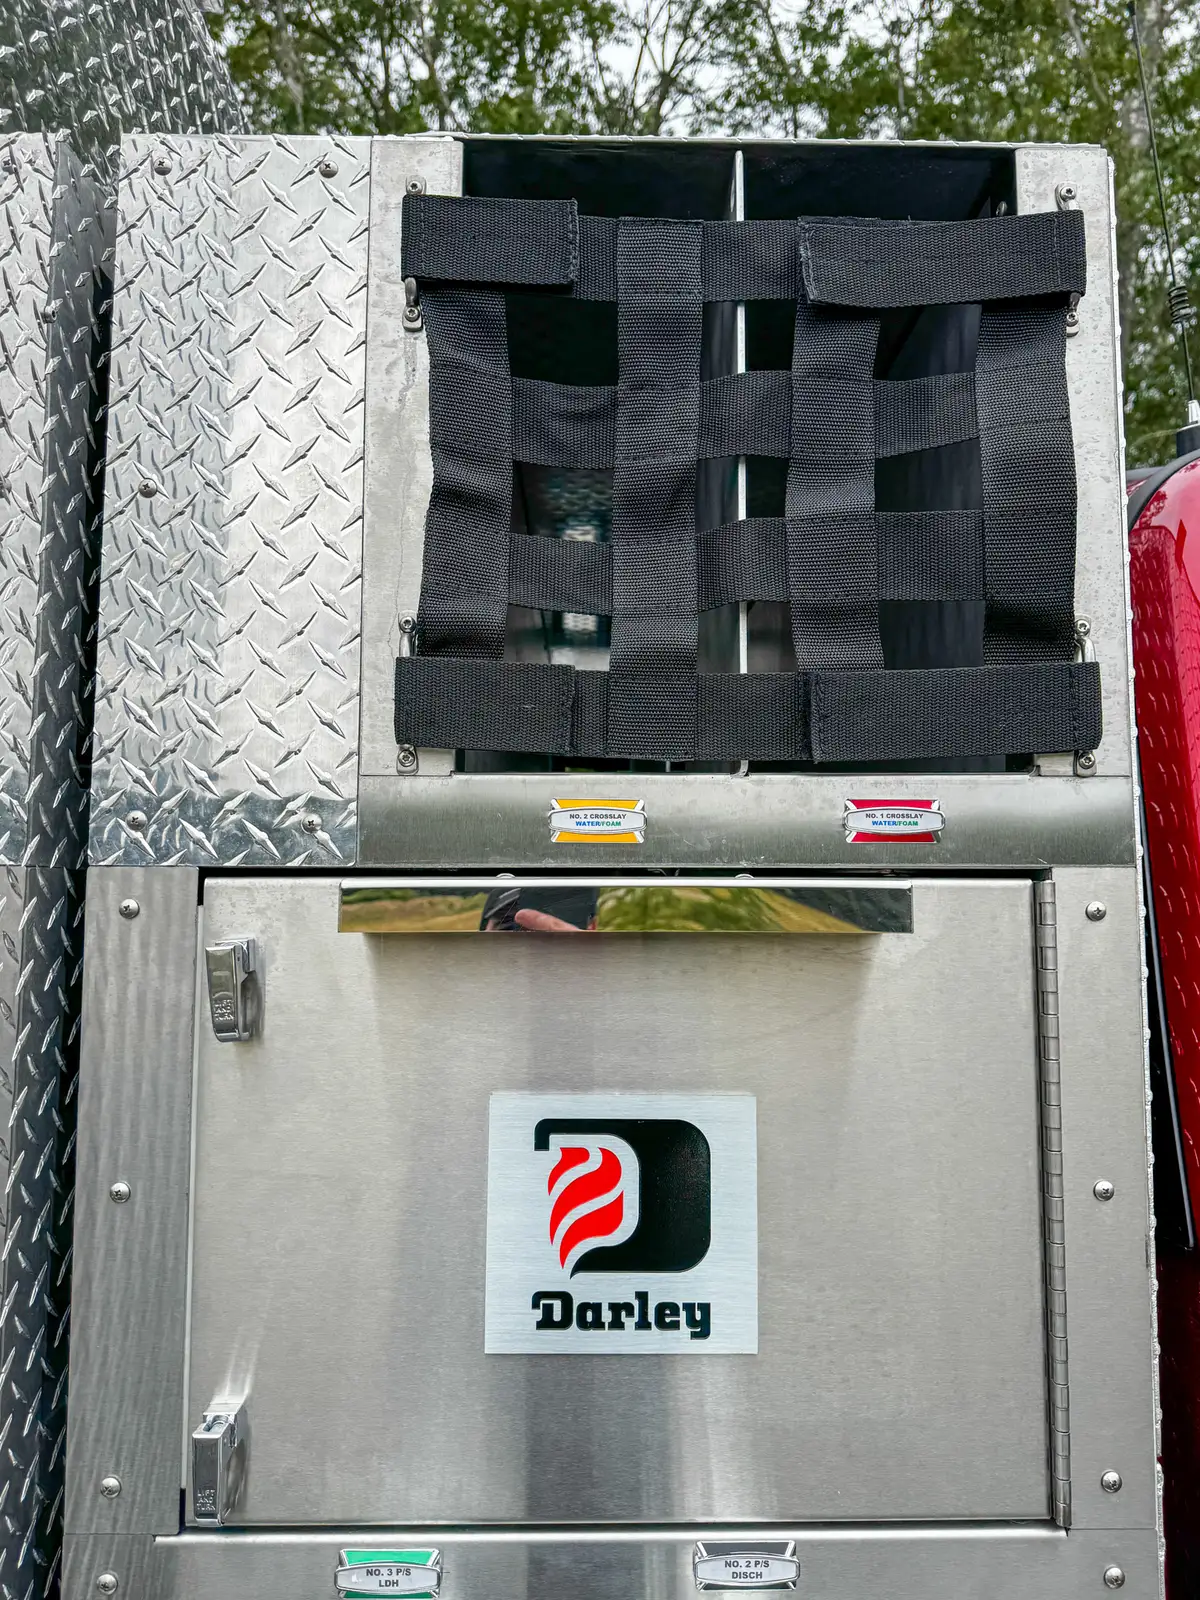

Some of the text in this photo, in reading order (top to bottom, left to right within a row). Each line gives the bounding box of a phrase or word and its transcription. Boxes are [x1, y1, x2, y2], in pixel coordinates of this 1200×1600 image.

[531, 1290, 711, 1340] Darley
[724, 1560, 770, 1568] NO. 2 P/S
[366, 1568, 412, 1577] NO. 3 P/S
[731, 1571, 763, 1579] DISCH
[378, 1579, 399, 1588] LDH
